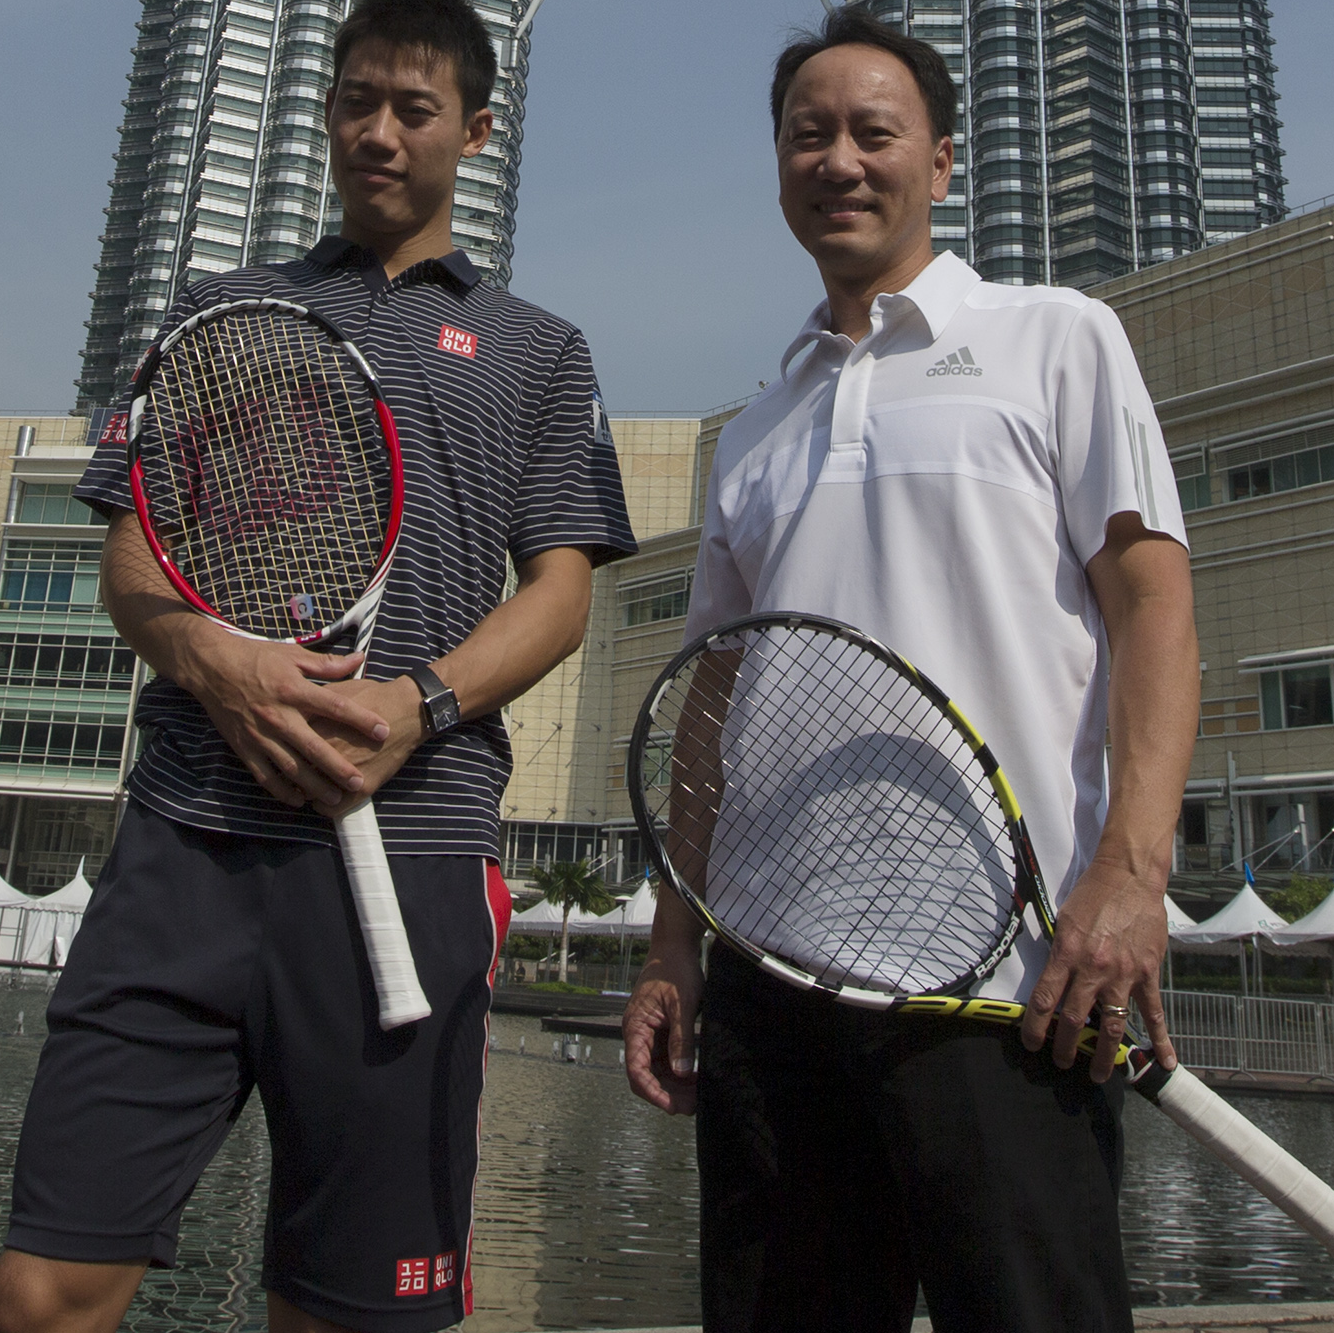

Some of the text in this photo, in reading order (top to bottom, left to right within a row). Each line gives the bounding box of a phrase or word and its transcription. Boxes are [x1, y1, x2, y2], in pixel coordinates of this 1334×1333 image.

[444, 328, 472, 345] UNI
[441, 337, 473, 354] QLO
[925, 363, 984, 378] adidas
[974, 910, 1020, 980] Babolat
[436, 1254, 453, 1271] UNI
[435, 1269, 453, 1287] QLO
